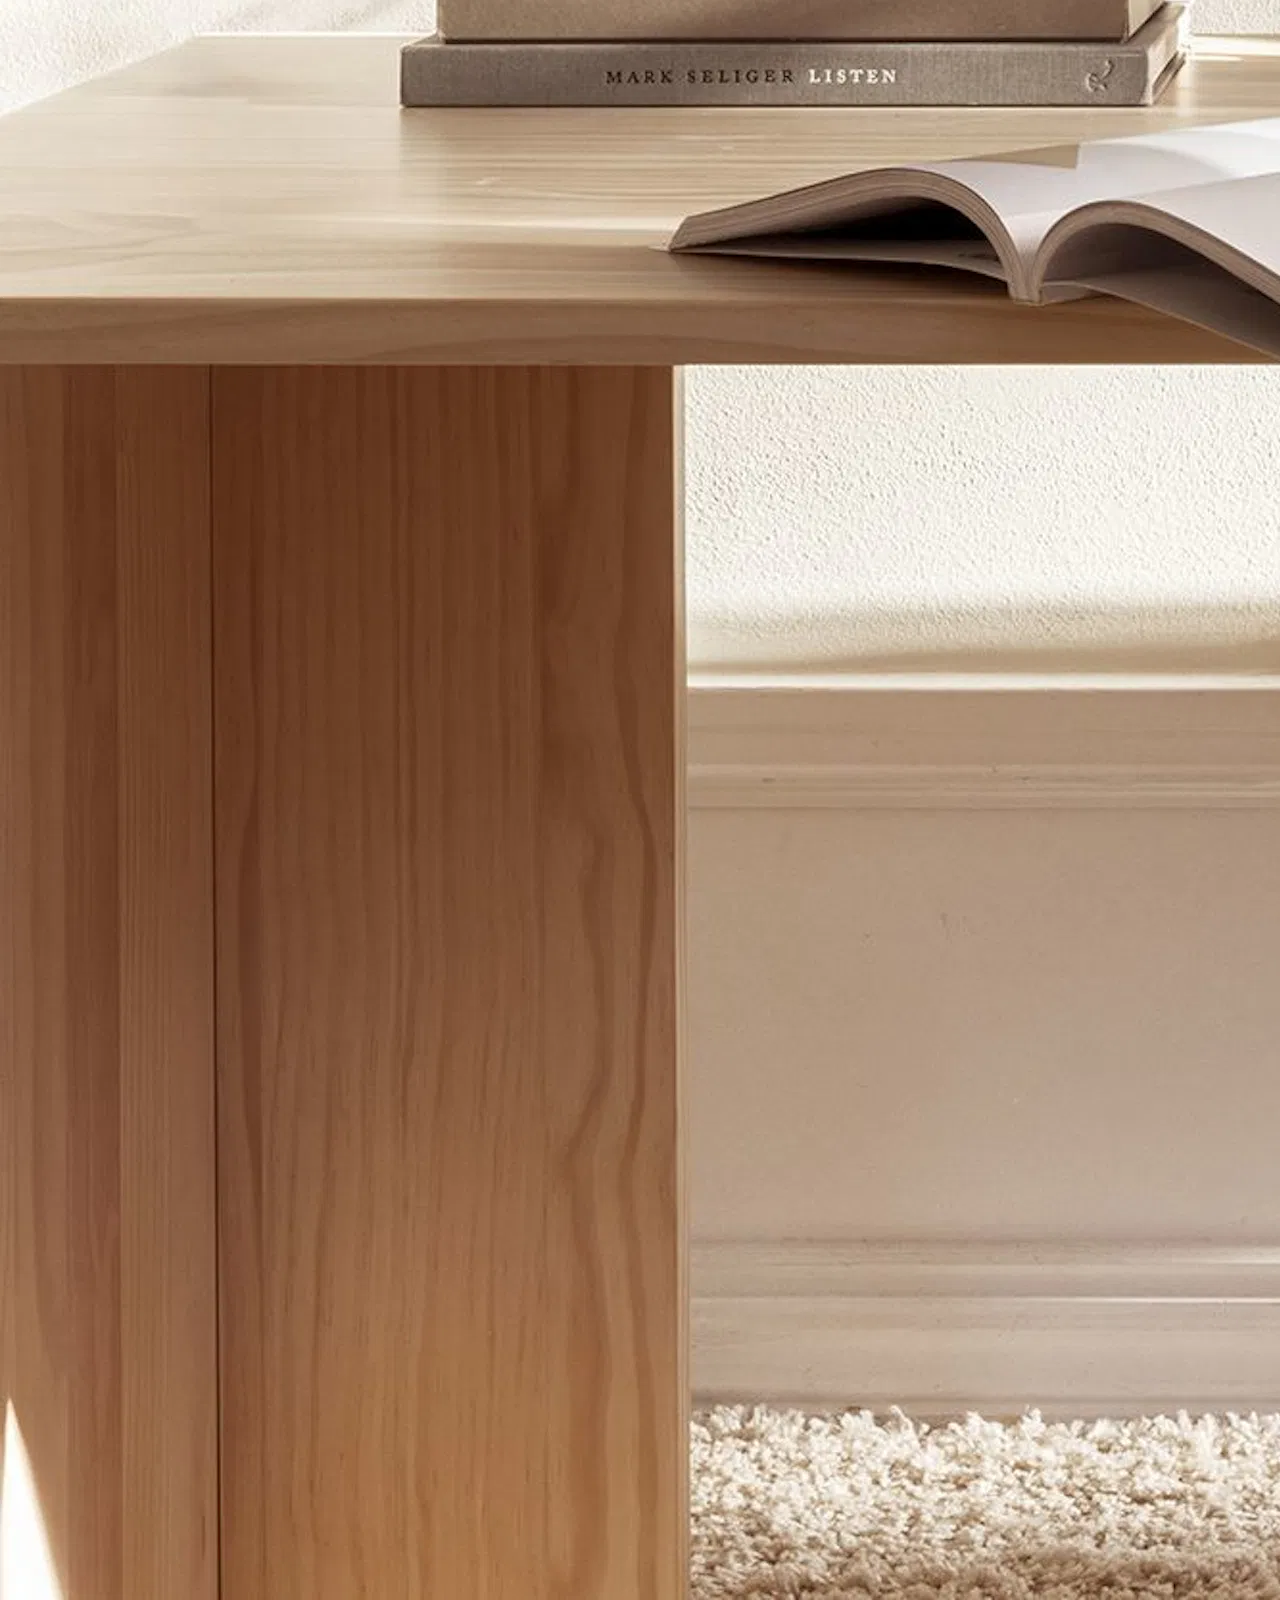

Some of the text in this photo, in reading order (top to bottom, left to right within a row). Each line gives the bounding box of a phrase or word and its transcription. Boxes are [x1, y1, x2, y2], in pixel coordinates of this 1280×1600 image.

[605, 68, 898, 85] MARK SELIGER LISTEN
